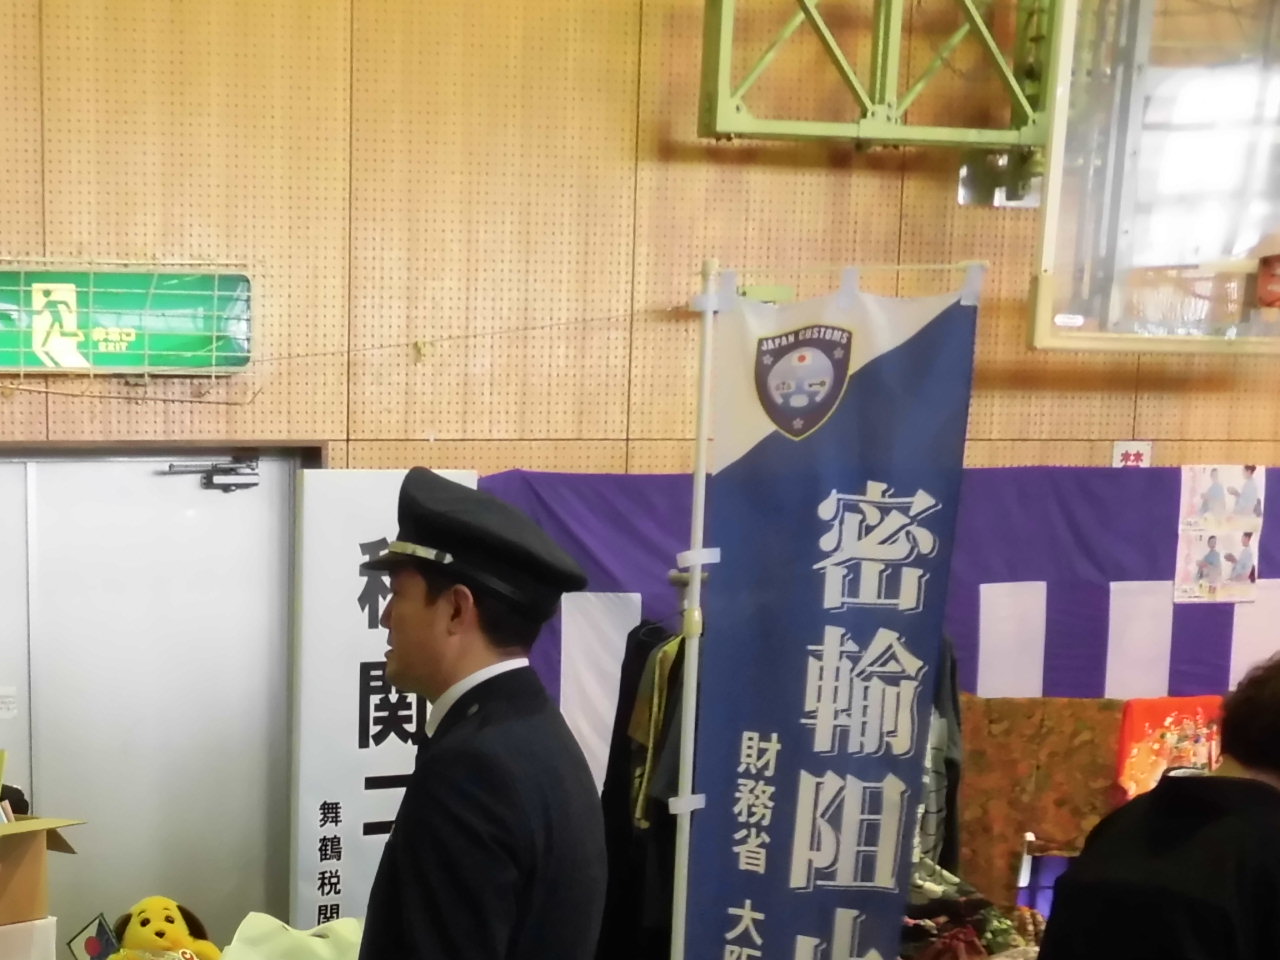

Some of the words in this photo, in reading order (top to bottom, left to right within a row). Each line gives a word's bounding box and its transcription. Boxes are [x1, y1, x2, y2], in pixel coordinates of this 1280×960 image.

[761, 333, 795, 351] JAPAN
[798, 327, 850, 344] CUSTOMS
[731, 731, 781, 875] 財務省
